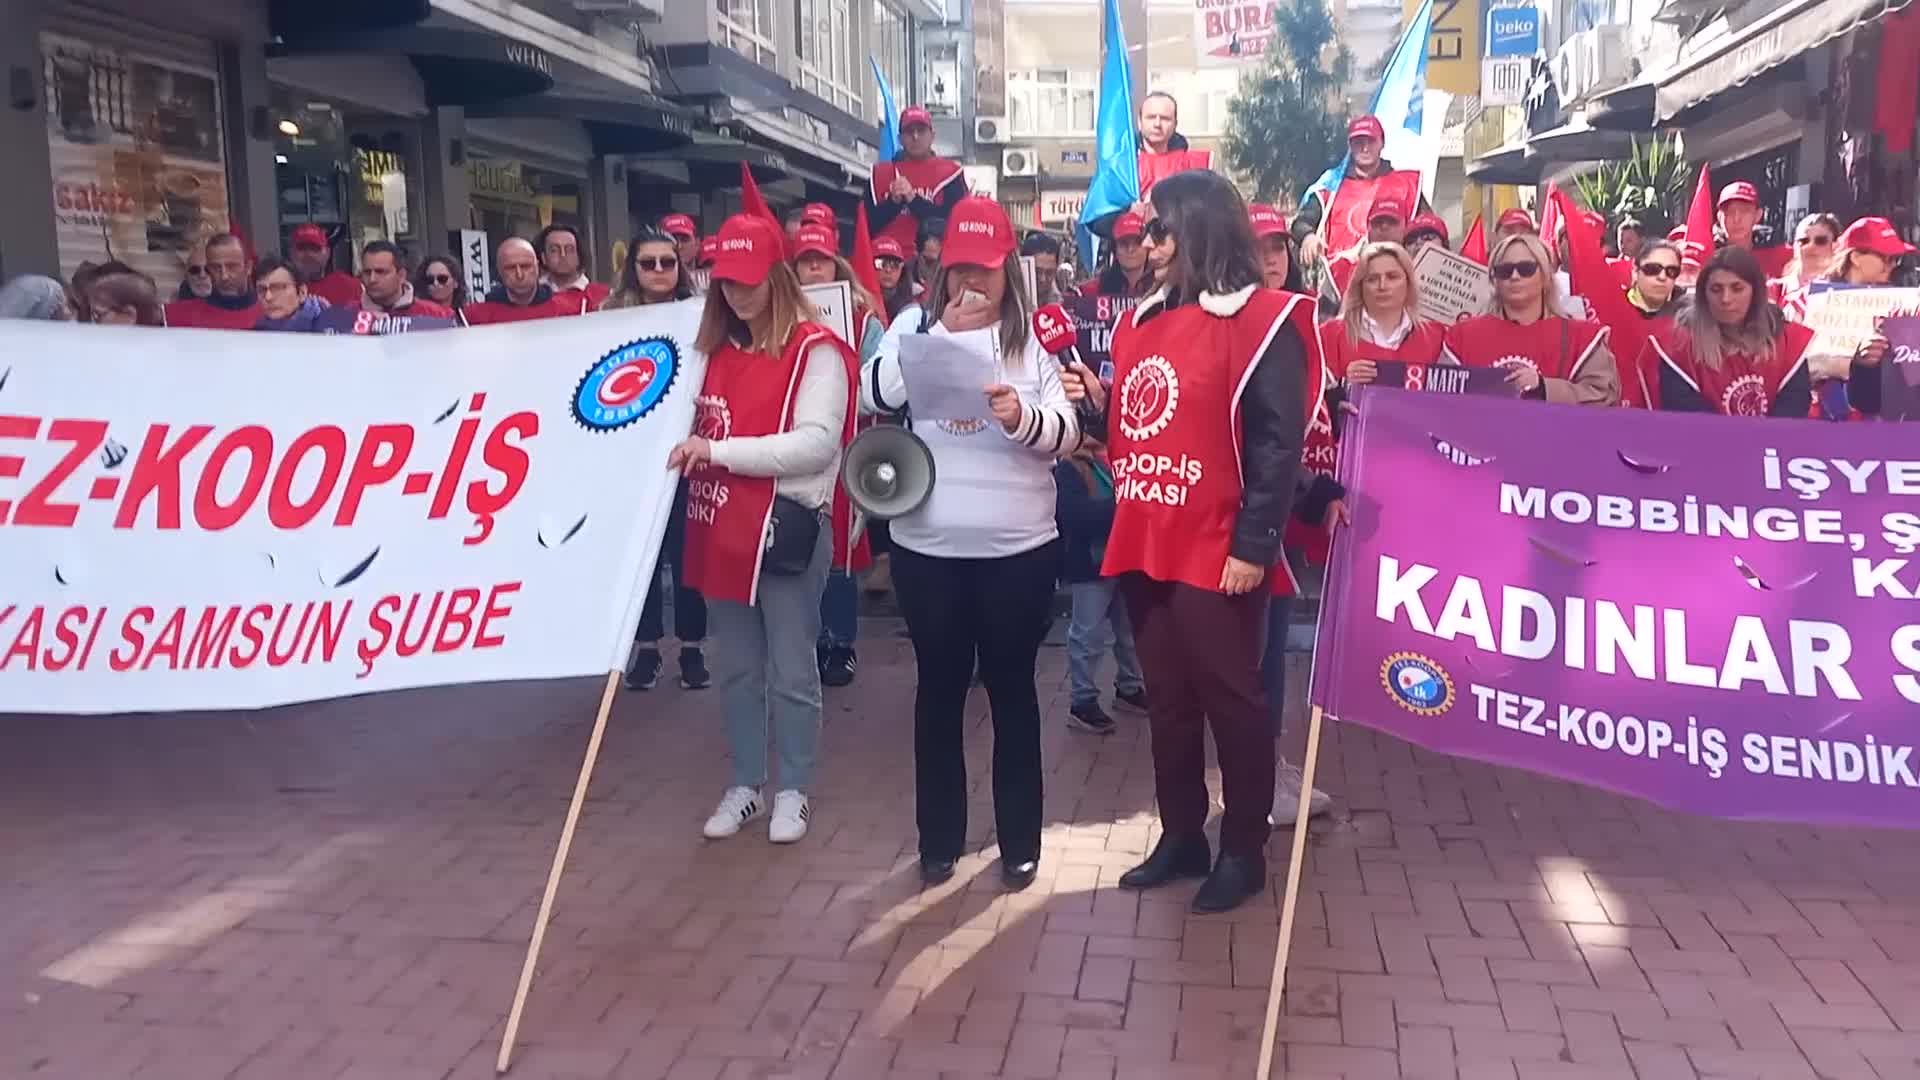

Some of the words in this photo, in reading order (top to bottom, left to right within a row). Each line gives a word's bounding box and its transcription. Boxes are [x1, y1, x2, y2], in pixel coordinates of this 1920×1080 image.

[1495, 19, 1534, 34] beko
[353, 310, 373, 334] 8
[1096, 296, 1111, 320] 8
[1405, 364, 1422, 392] 8
[1425, 367, 1470, 395] MART
[1763, 447, 1920, 500] İŞYE
[1499, 483, 1866, 552] MOBBİNGE,
[1852, 556, 1920, 600] K
[109, 598, 353, 673] SAMSUN
[355, 580, 523, 679] ŞUBE
[1375, 553, 1864, 702] KADINLAR
[1470, 682, 1729, 780] TEZ-KOOP-İŞ
[1742, 732, 1920, 788] SENDİK
